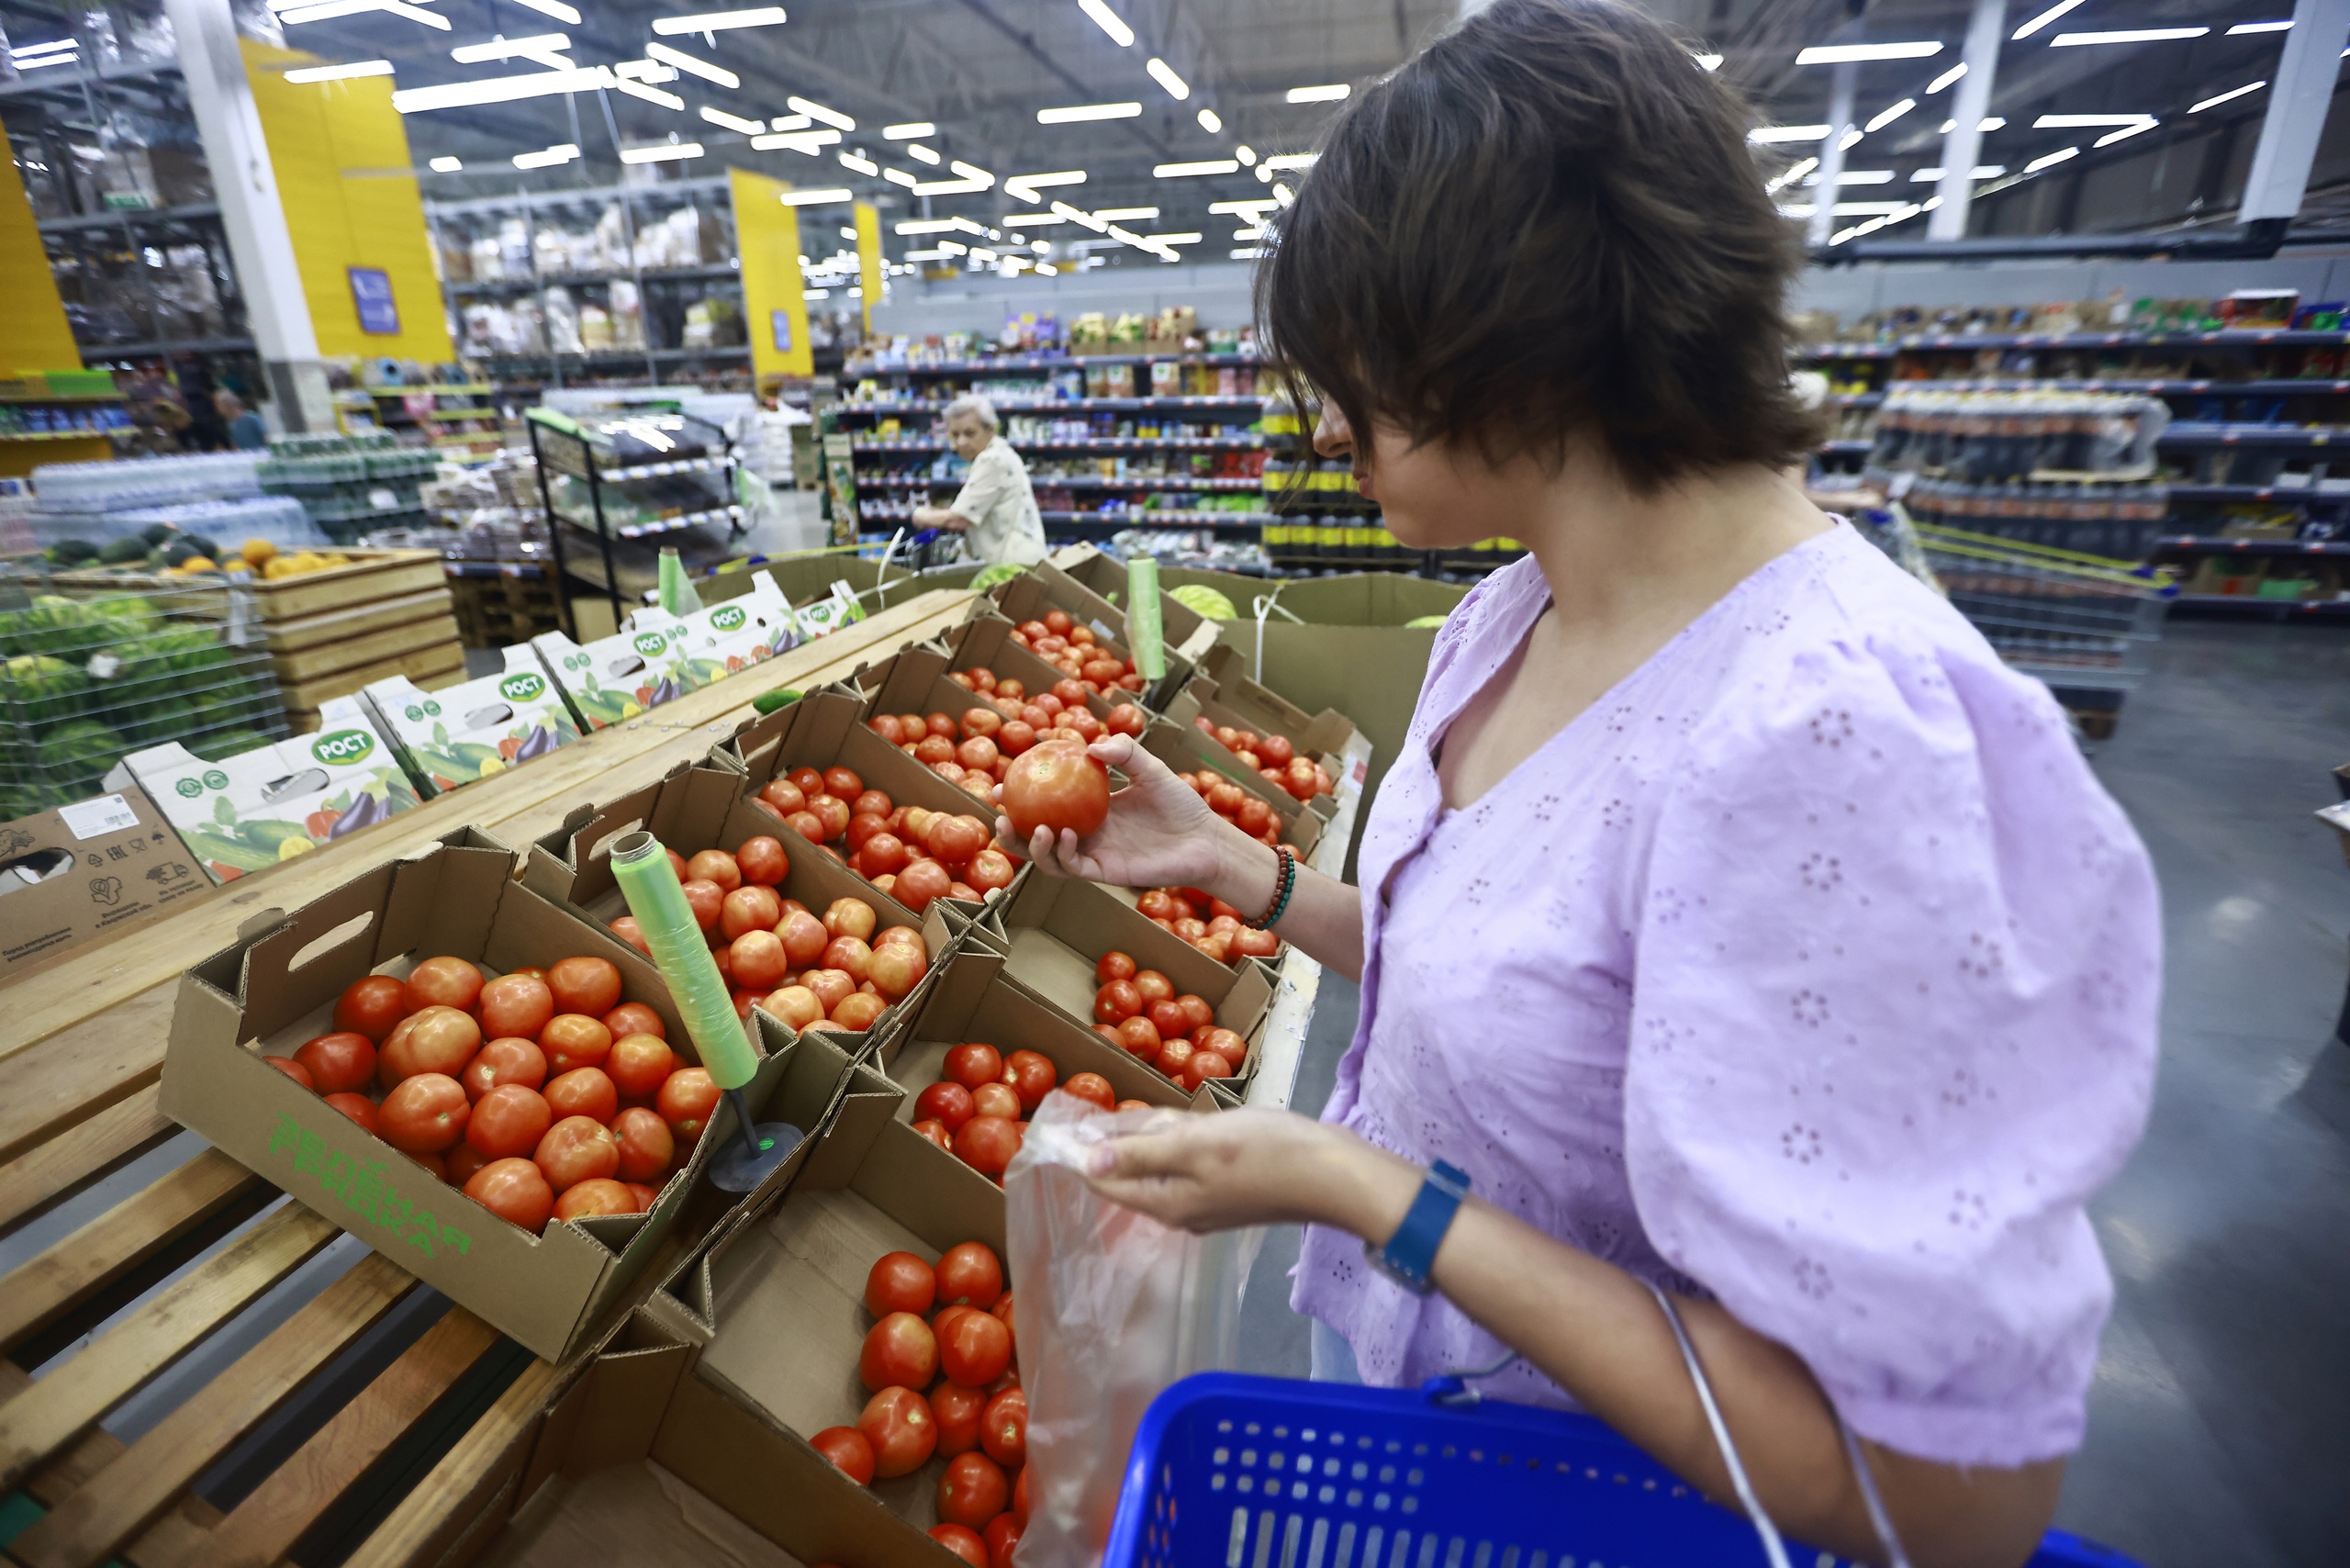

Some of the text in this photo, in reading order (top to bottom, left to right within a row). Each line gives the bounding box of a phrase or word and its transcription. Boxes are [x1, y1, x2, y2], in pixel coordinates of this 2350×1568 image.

[503, 676, 539, 698] РОСТ
[318, 734, 366, 760] РОСТ
[270, 1134, 434, 1260] ГРЯДКА
